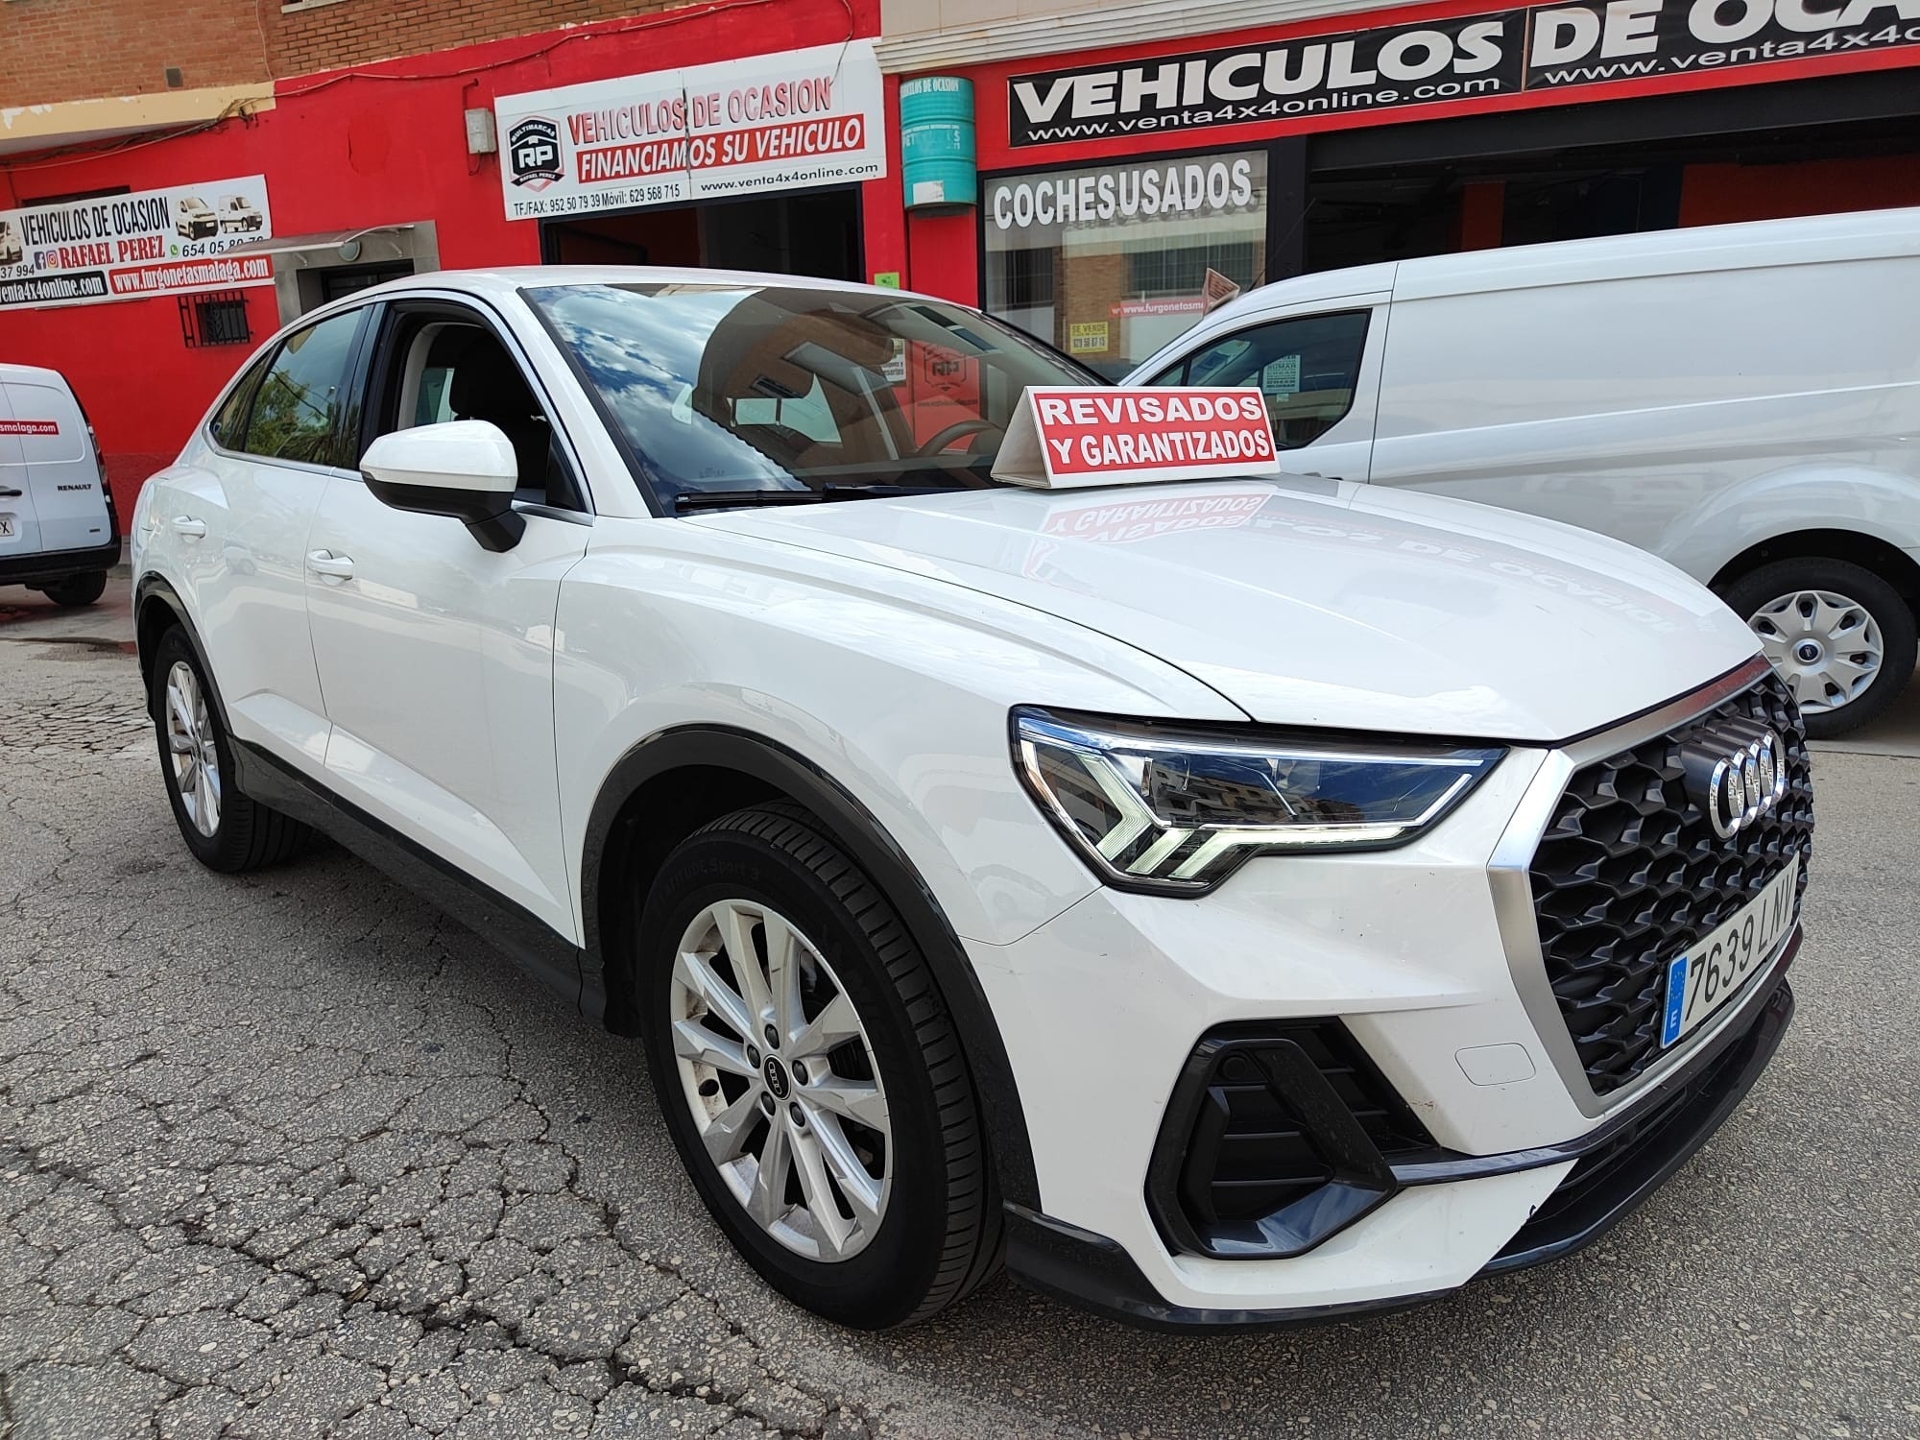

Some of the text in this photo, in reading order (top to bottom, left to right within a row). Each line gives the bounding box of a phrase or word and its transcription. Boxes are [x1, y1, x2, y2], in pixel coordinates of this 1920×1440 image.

[1013, 21, 1503, 123] VEHICULOS
[1530, 0, 1661, 68] DE
[567, 76, 832, 145] VEHICULOS DE OCASION
[1028, 77, 1500, 141] www.venta4x4online.com
[511, 124, 556, 143] MULTIMARCAS
[581, 137, 716, 181] FINANCIAMOS
[722, 131, 749, 163] SU
[756, 117, 861, 159] VEHICULO
[518, 145, 554, 168] RP
[700, 163, 879, 192] www.venta4x4online.com
[994, 158, 1252, 230] COCHESUSADOS
[550, 199, 565, 213] 952
[567, 196, 577, 210] 50
[578, 195, 589, 209] 79
[590, 193, 601, 208] 39
[630, 188, 645, 203] 629
[647, 186, 662, 200] 568
[664, 183, 680, 198] 715
[20, 196, 171, 247] VEHICULOS DE OCASION
[58, 235, 166, 269] RAFAEL PEREZ
[182, 243, 205, 257] 654
[209, 240, 224, 255] 05
[16, 264, 35, 277] 994
[113, 258, 269, 294] www.furgonetasmalaga.com
[1038, 396, 1263, 426] REVISADOS
[1050, 429, 1270, 467] Y GARANTIZADOS
[57, 484, 92, 492] RENAULT
[1685, 866, 1795, 1022] 7639 LNV
